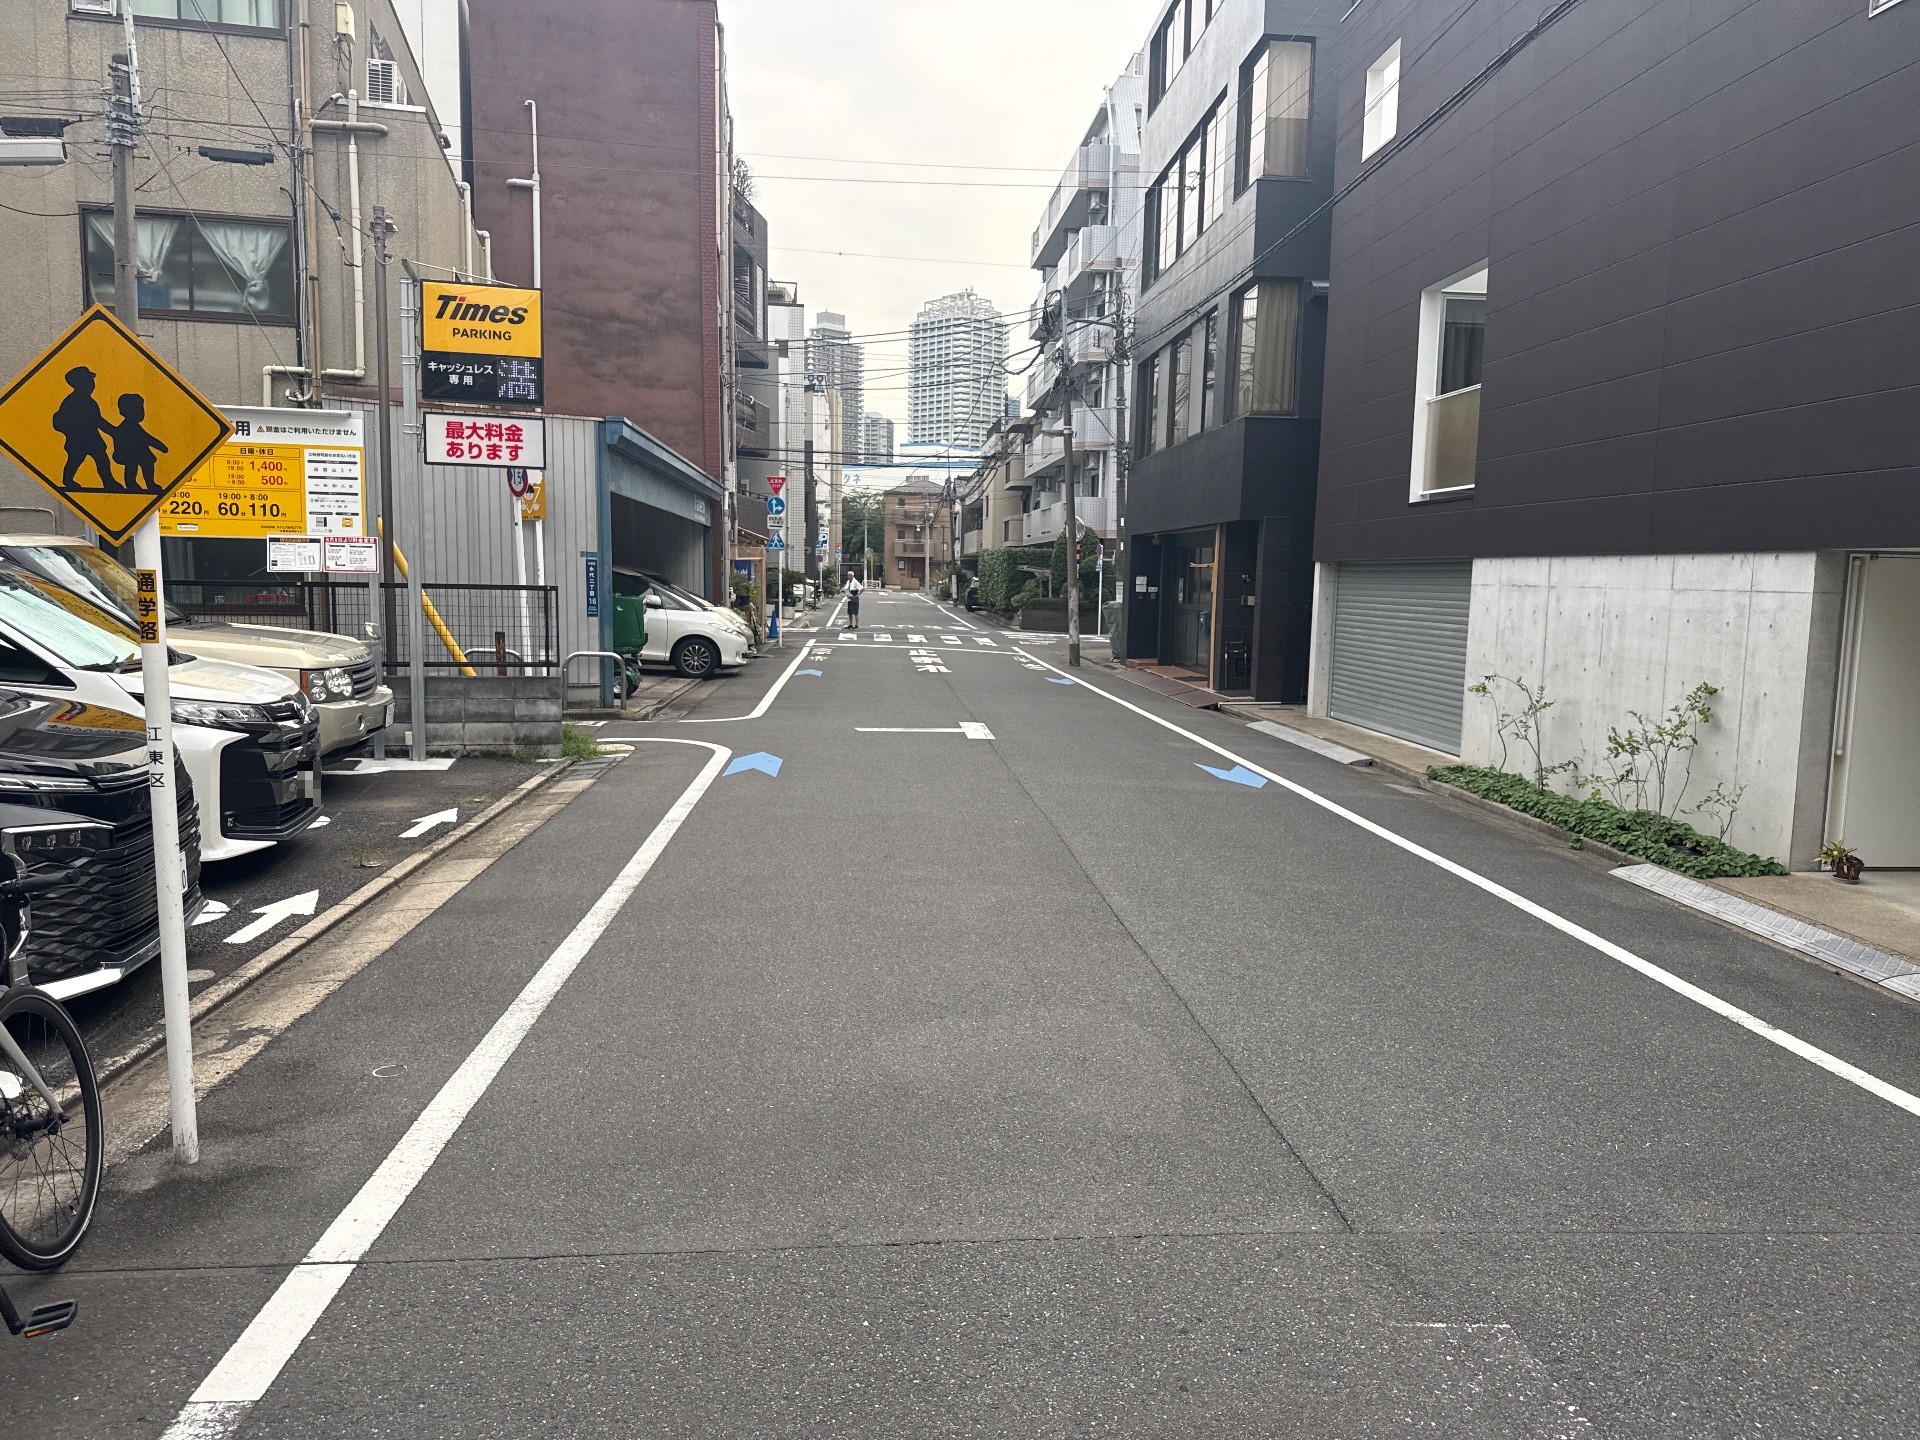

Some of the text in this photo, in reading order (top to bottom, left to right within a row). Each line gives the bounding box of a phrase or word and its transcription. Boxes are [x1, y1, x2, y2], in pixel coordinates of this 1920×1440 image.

[436, 294, 529, 325] Times
[452, 327, 512, 341] PARKING
[427, 361, 494, 375] キャッシュレス
[448, 375, 473, 386] 専用
[498, 359, 537, 400] 満
[265, 426, 357, 436] 現金はご利用いただけません
[445, 421, 524, 443] 最大料金
[240, 447, 274, 456] 日曜・休日
[446, 441, 524, 461] あります
[843, 474, 861, 484] タネ
[218, 492, 241, 500] 19:00
[136, 572, 158, 642] 通学路
[147, 726, 166, 788] 江東区
